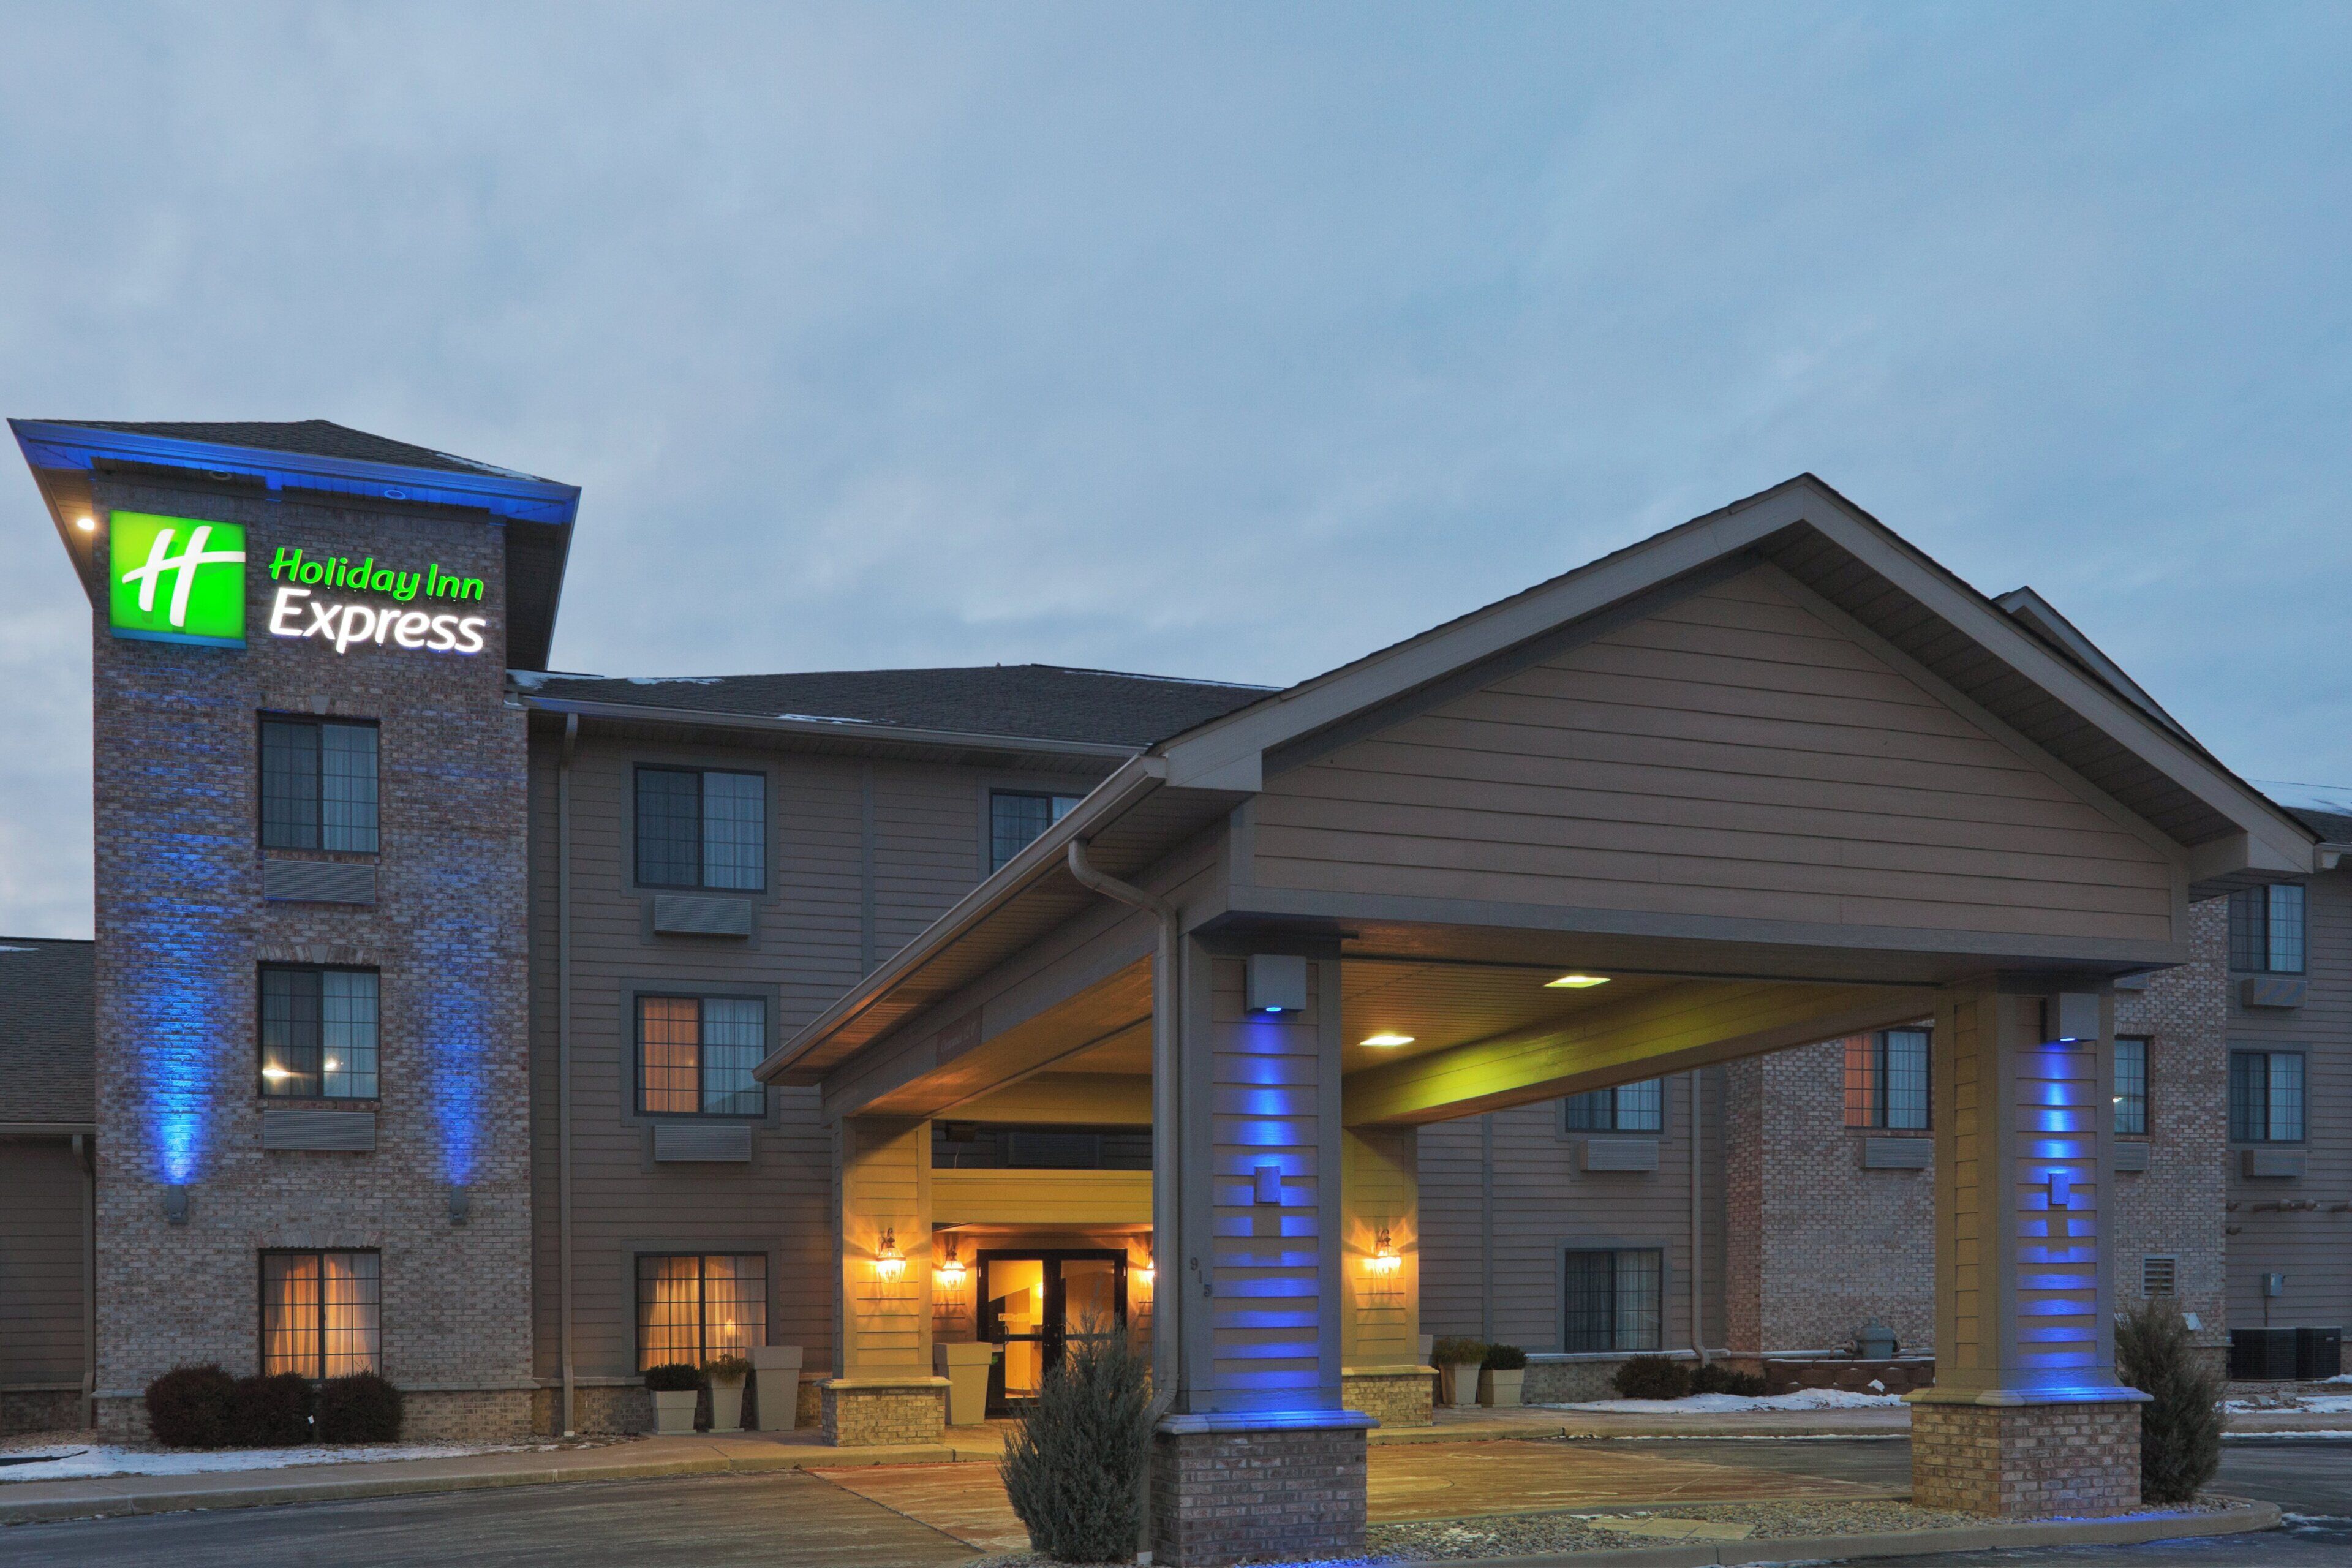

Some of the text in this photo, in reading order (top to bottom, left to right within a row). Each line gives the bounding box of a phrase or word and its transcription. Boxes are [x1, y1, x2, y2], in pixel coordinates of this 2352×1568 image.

[269, 547, 484, 601] Holiday Inn
[270, 587, 486, 654] Express
[1190, 1257, 1212, 1297] 915
